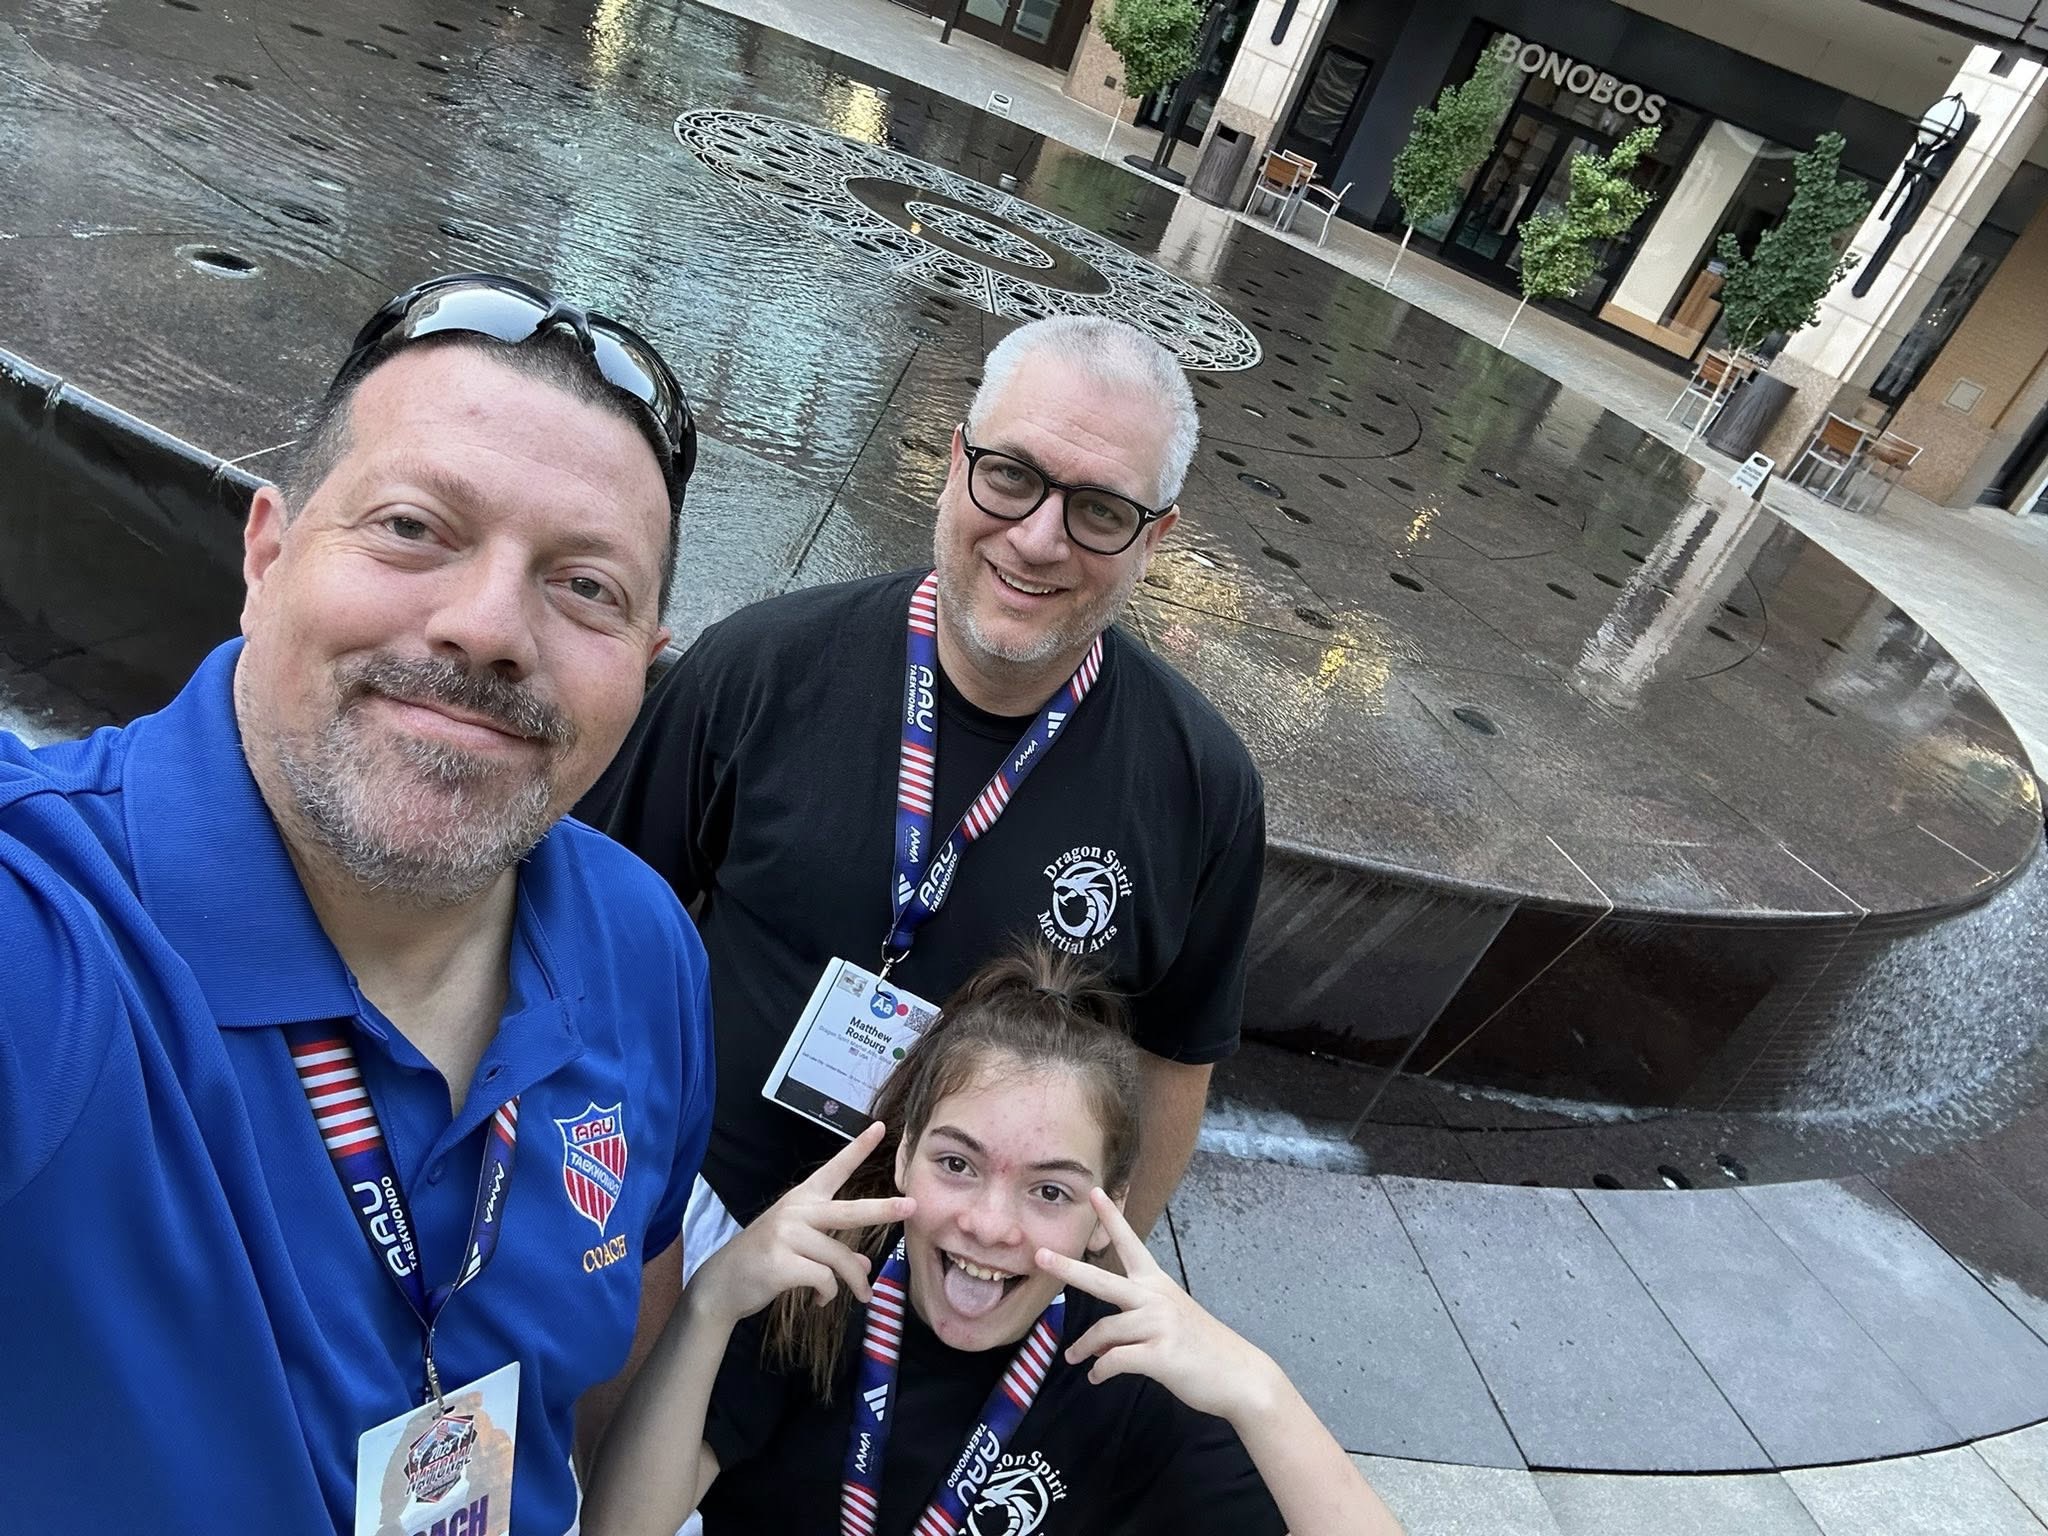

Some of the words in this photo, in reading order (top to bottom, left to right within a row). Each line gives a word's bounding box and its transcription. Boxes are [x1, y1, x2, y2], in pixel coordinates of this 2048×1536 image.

[1496, 32, 1666, 124] BONOBOS
[906, 663, 918, 725] TAEKWONDO
[916, 665, 934, 733] AAU
[919, 840, 954, 907] AAU
[929, 853, 958, 913] TAEKWONDO
[1043, 846, 1101, 881] Dragon
[1103, 849, 1133, 897] Spirit
[1037, 909, 1085, 954] Martial
[1089, 925, 1118, 953] Arts
[845, 1027, 886, 1055] Rosburg
[850, 1016, 893, 1043] Matthew
[575, 1117, 613, 1142] AAU
[352, 1181, 411, 1277] AAU
[381, 1176, 418, 1271] TAEKWONDO
[583, 1234, 627, 1273] COACH
[947, 1423, 987, 1488] TAEKWONDO
[956, 1430, 1000, 1508] AAU
[1027, 1450, 1068, 1501] Spirit
